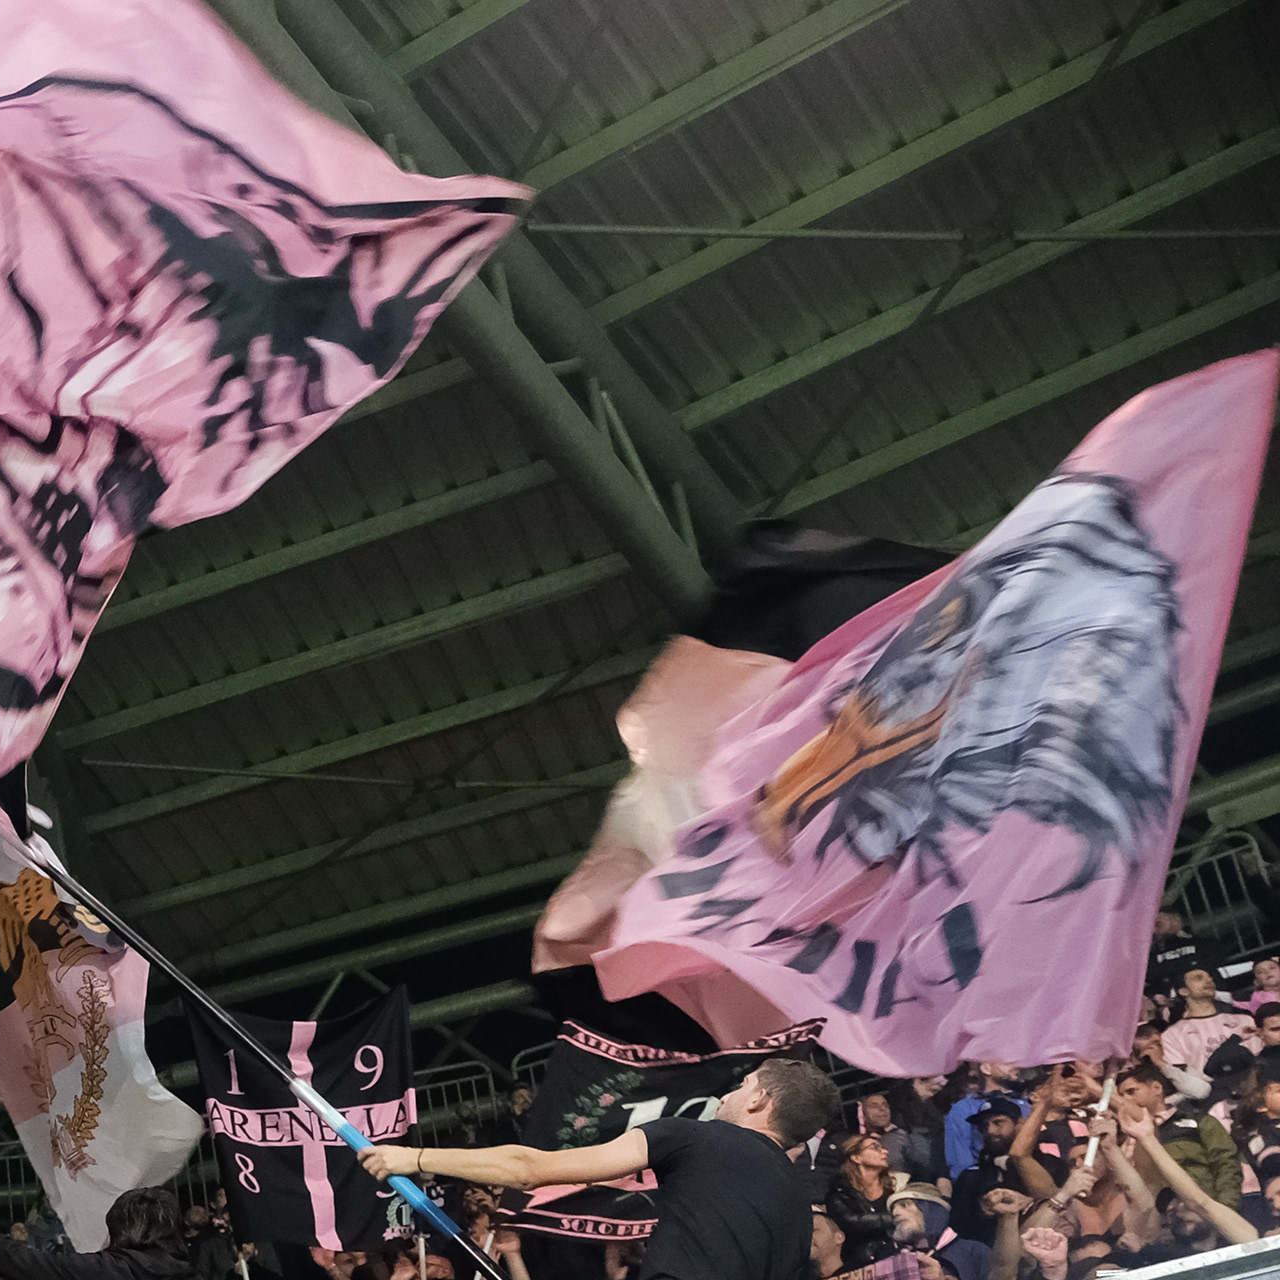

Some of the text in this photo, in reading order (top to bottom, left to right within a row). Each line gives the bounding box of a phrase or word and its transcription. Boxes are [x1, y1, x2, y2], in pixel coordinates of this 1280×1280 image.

[223, 1044, 384, 1096] 1 9
[234, 1152, 261, 1193] 8
[558, 1217, 614, 1237] SOLO
